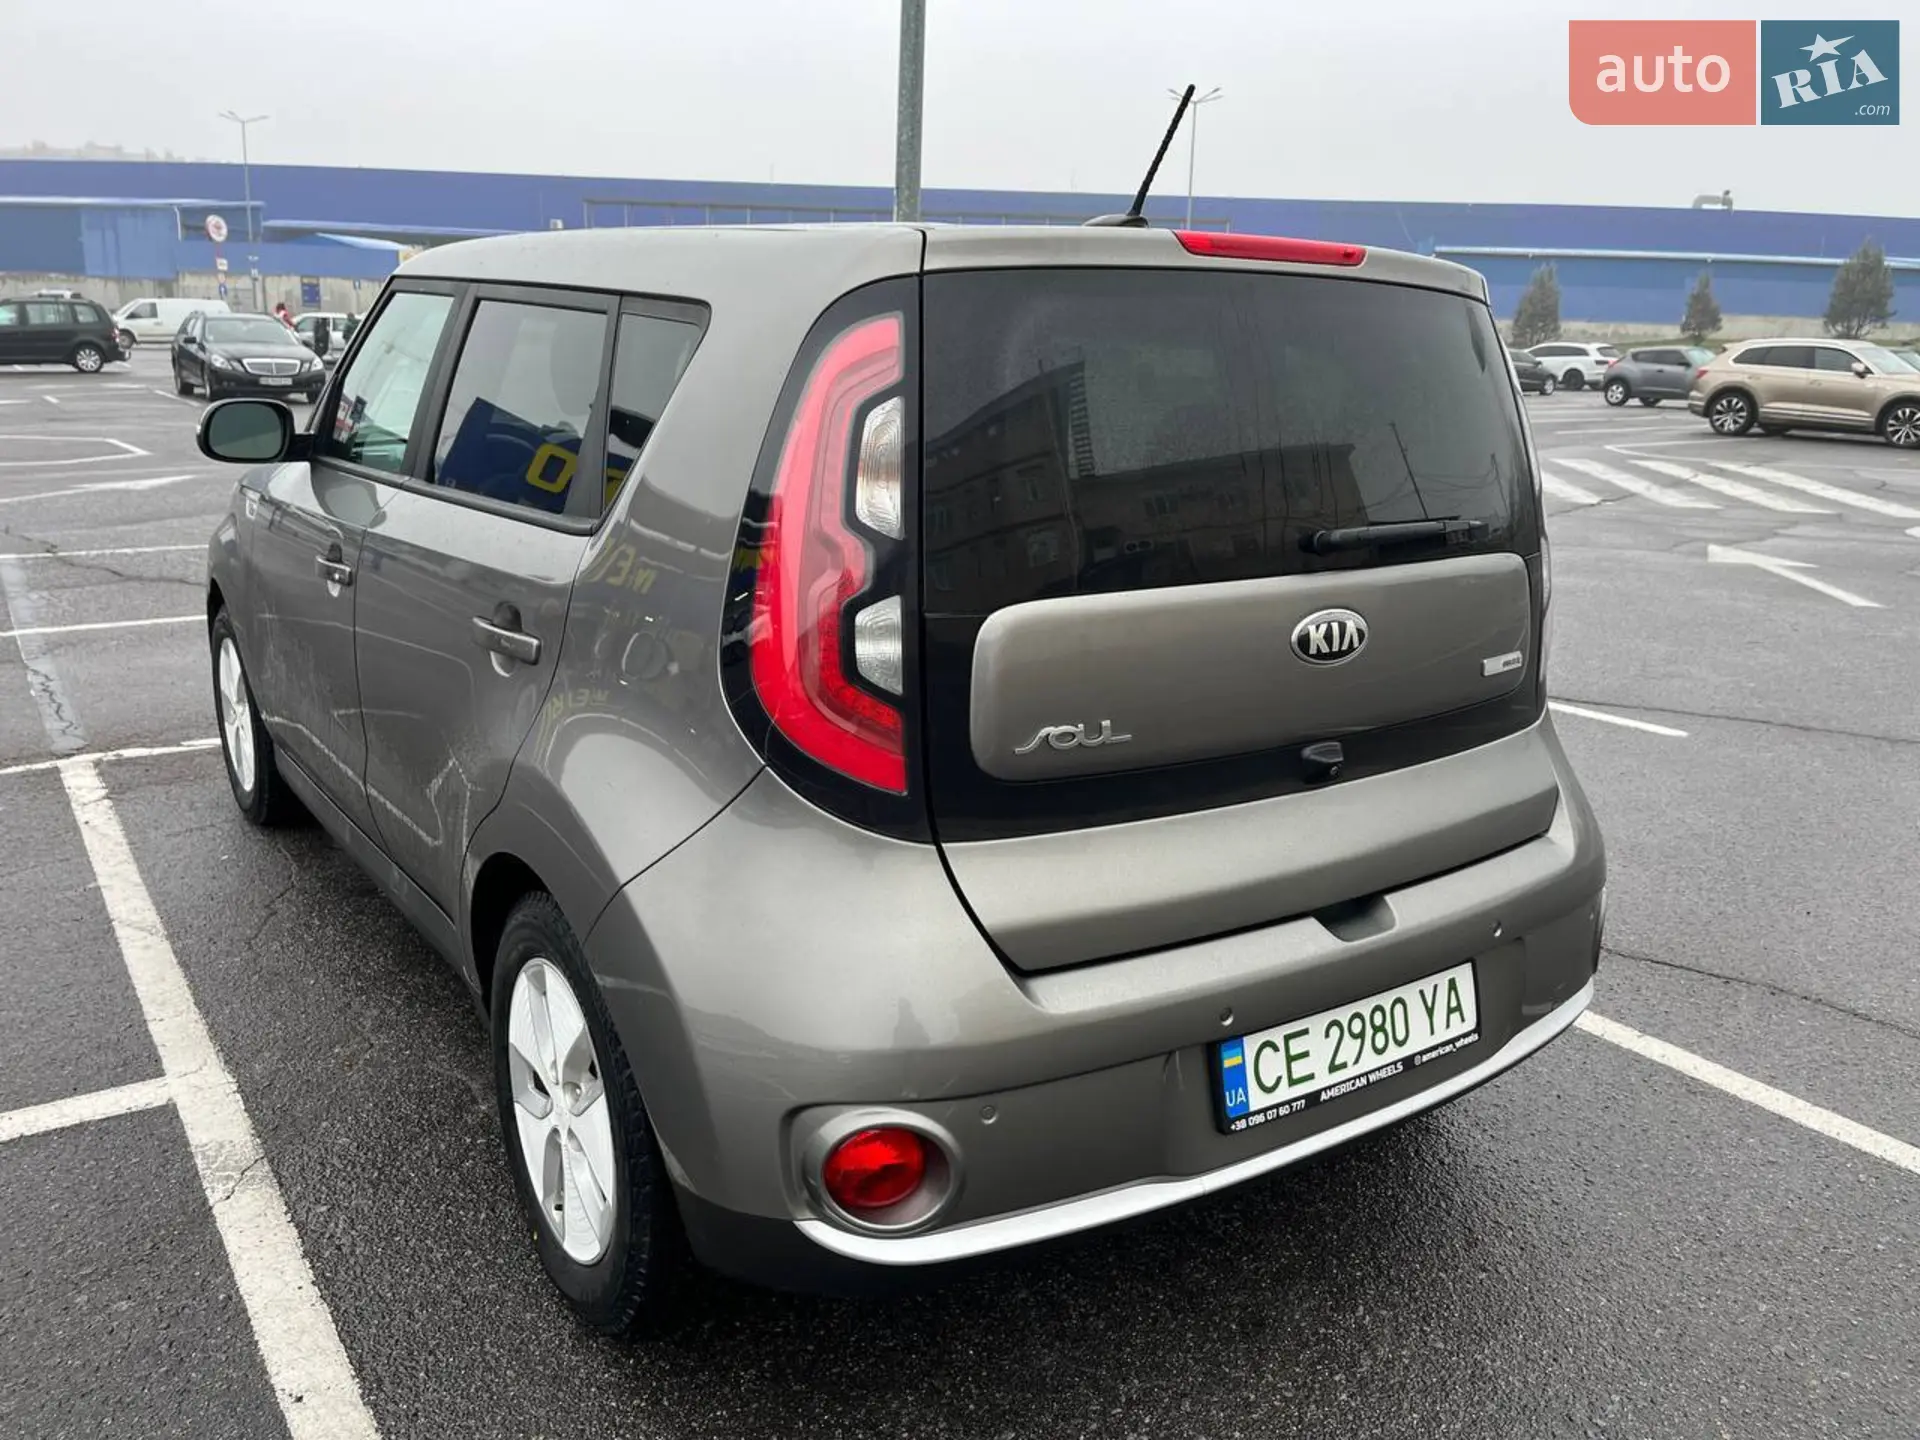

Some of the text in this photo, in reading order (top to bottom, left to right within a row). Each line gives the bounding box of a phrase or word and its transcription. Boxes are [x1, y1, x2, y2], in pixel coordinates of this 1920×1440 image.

[1307, 620, 1360, 655] KIA
[1253, 976, 1466, 1095] CE 2980 YA
[1225, 1086, 1247, 1107] UA
[1320, 1061, 1404, 1102] AMERICAN WHEELS
[1266, 1108, 1278, 1120] 07
[1278, 1104, 1291, 1117] 60
[1290, 1099, 1306, 1112] 777
